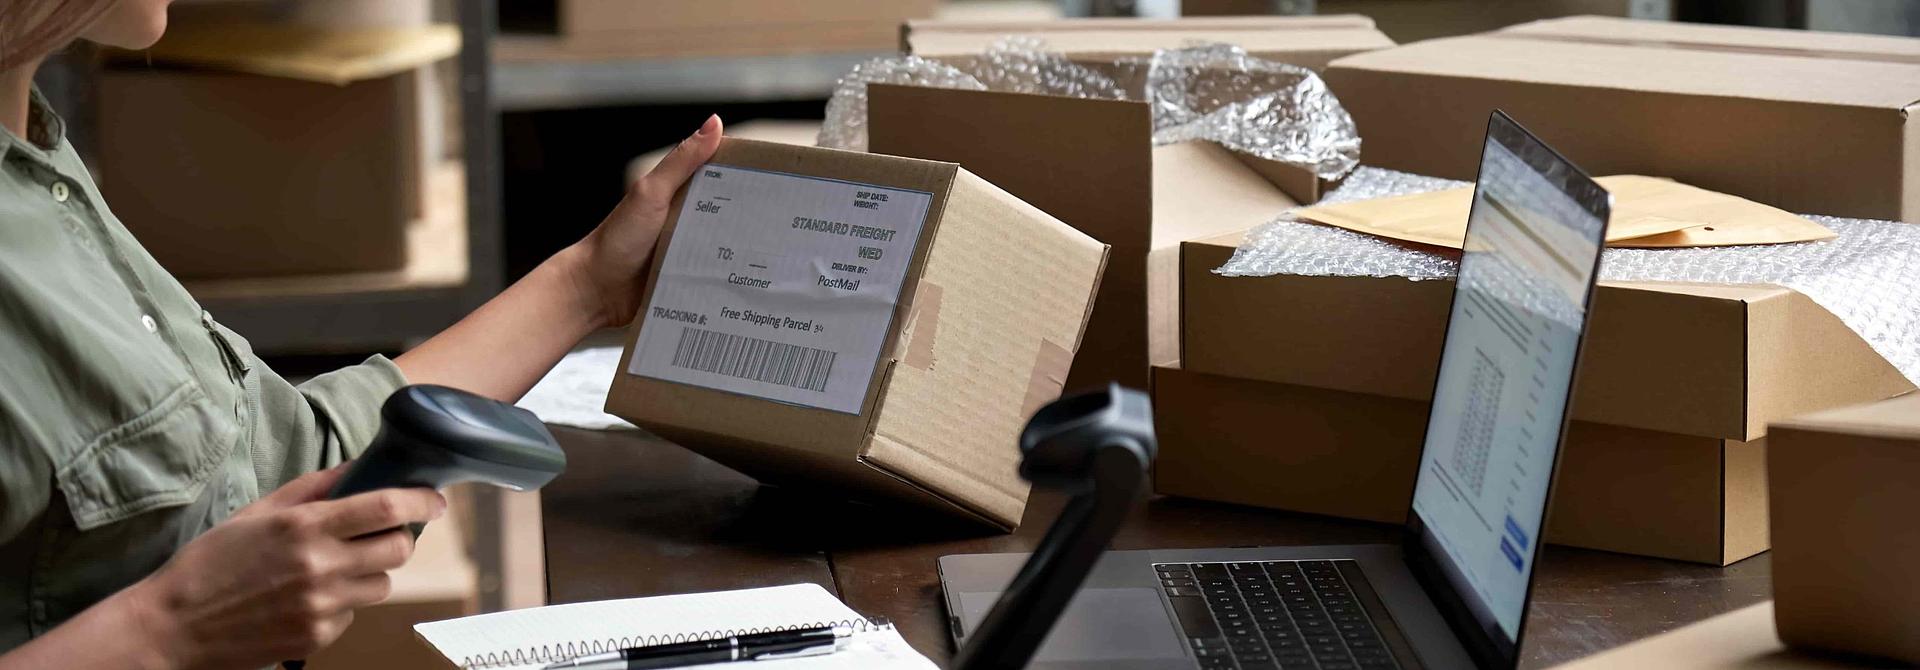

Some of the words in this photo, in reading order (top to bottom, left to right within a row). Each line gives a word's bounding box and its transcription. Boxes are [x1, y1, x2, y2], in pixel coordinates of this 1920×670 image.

[856, 191, 870, 200] SHIP
[871, 192, 889, 202] DATE:
[695, 201, 721, 214] Seller
[854, 200, 879, 210] WEIGHT:
[792, 216, 848, 235] STANDARD
[850, 225, 896, 242] FREIGHT
[717, 247, 734, 261] TO:
[857, 246, 883, 261] WED
[831, 262, 857, 273] DELIVER
[857, 265, 868, 275] BY:
[727, 272, 771, 289] Customer
[817, 275, 860, 291] PostMail
[652, 306, 697, 324] TRACKING
[720, 306, 741, 320] Free
[741, 310, 781, 329] Shipping
[782, 316, 812, 332] Parcel
